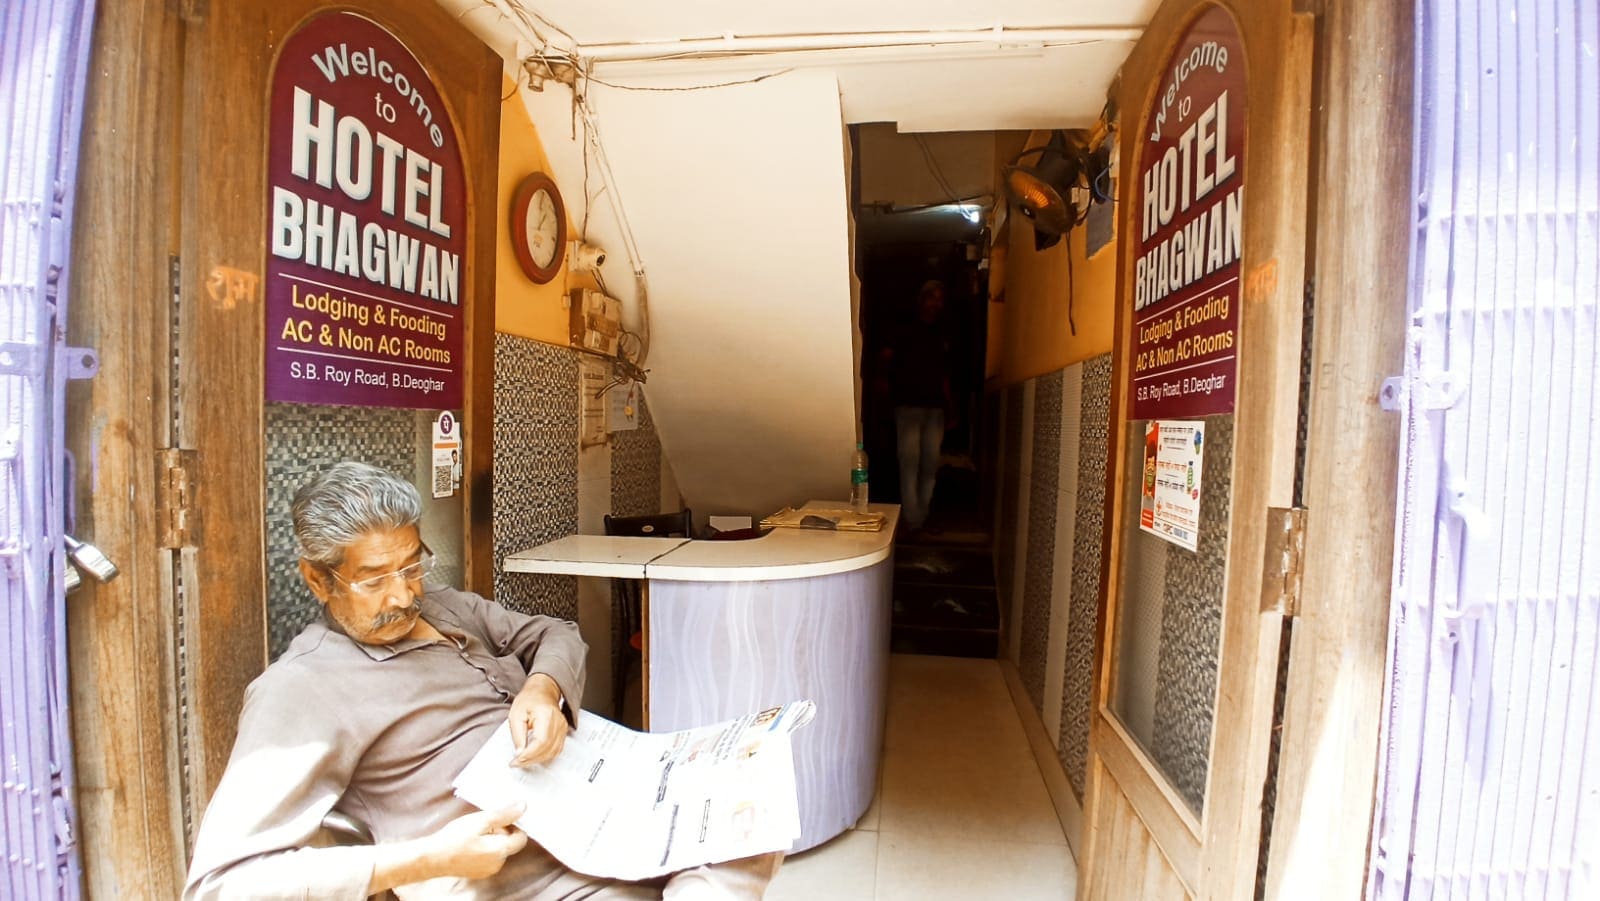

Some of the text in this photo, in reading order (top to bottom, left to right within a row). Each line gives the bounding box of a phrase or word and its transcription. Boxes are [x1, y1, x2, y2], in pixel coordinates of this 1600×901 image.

[311, 43, 443, 148] Welcome
[375, 92, 396, 123] to
[1150, 40, 1229, 142] Welcome
[1178, 95, 1192, 122] to
[291, 86, 451, 239] HOTEL
[1142, 89, 1236, 244] HOTEL
[272, 185, 459, 305] BHAGWAN
[1135, 184, 1245, 312] BHAGWAN
[292, 284, 446, 341] Lodging & Fooding
[1140, 295, 1230, 345] Lodging & Fooding
[281, 317, 451, 364] AC & Non AC Rooms
[1136, 330, 1234, 372] AC & Non AC Rooms
[290, 361, 445, 394] S.B. Roy Road, B.Deoghar
[1137, 373, 1226, 402] S.B. Roy Road, B.Deoghar
